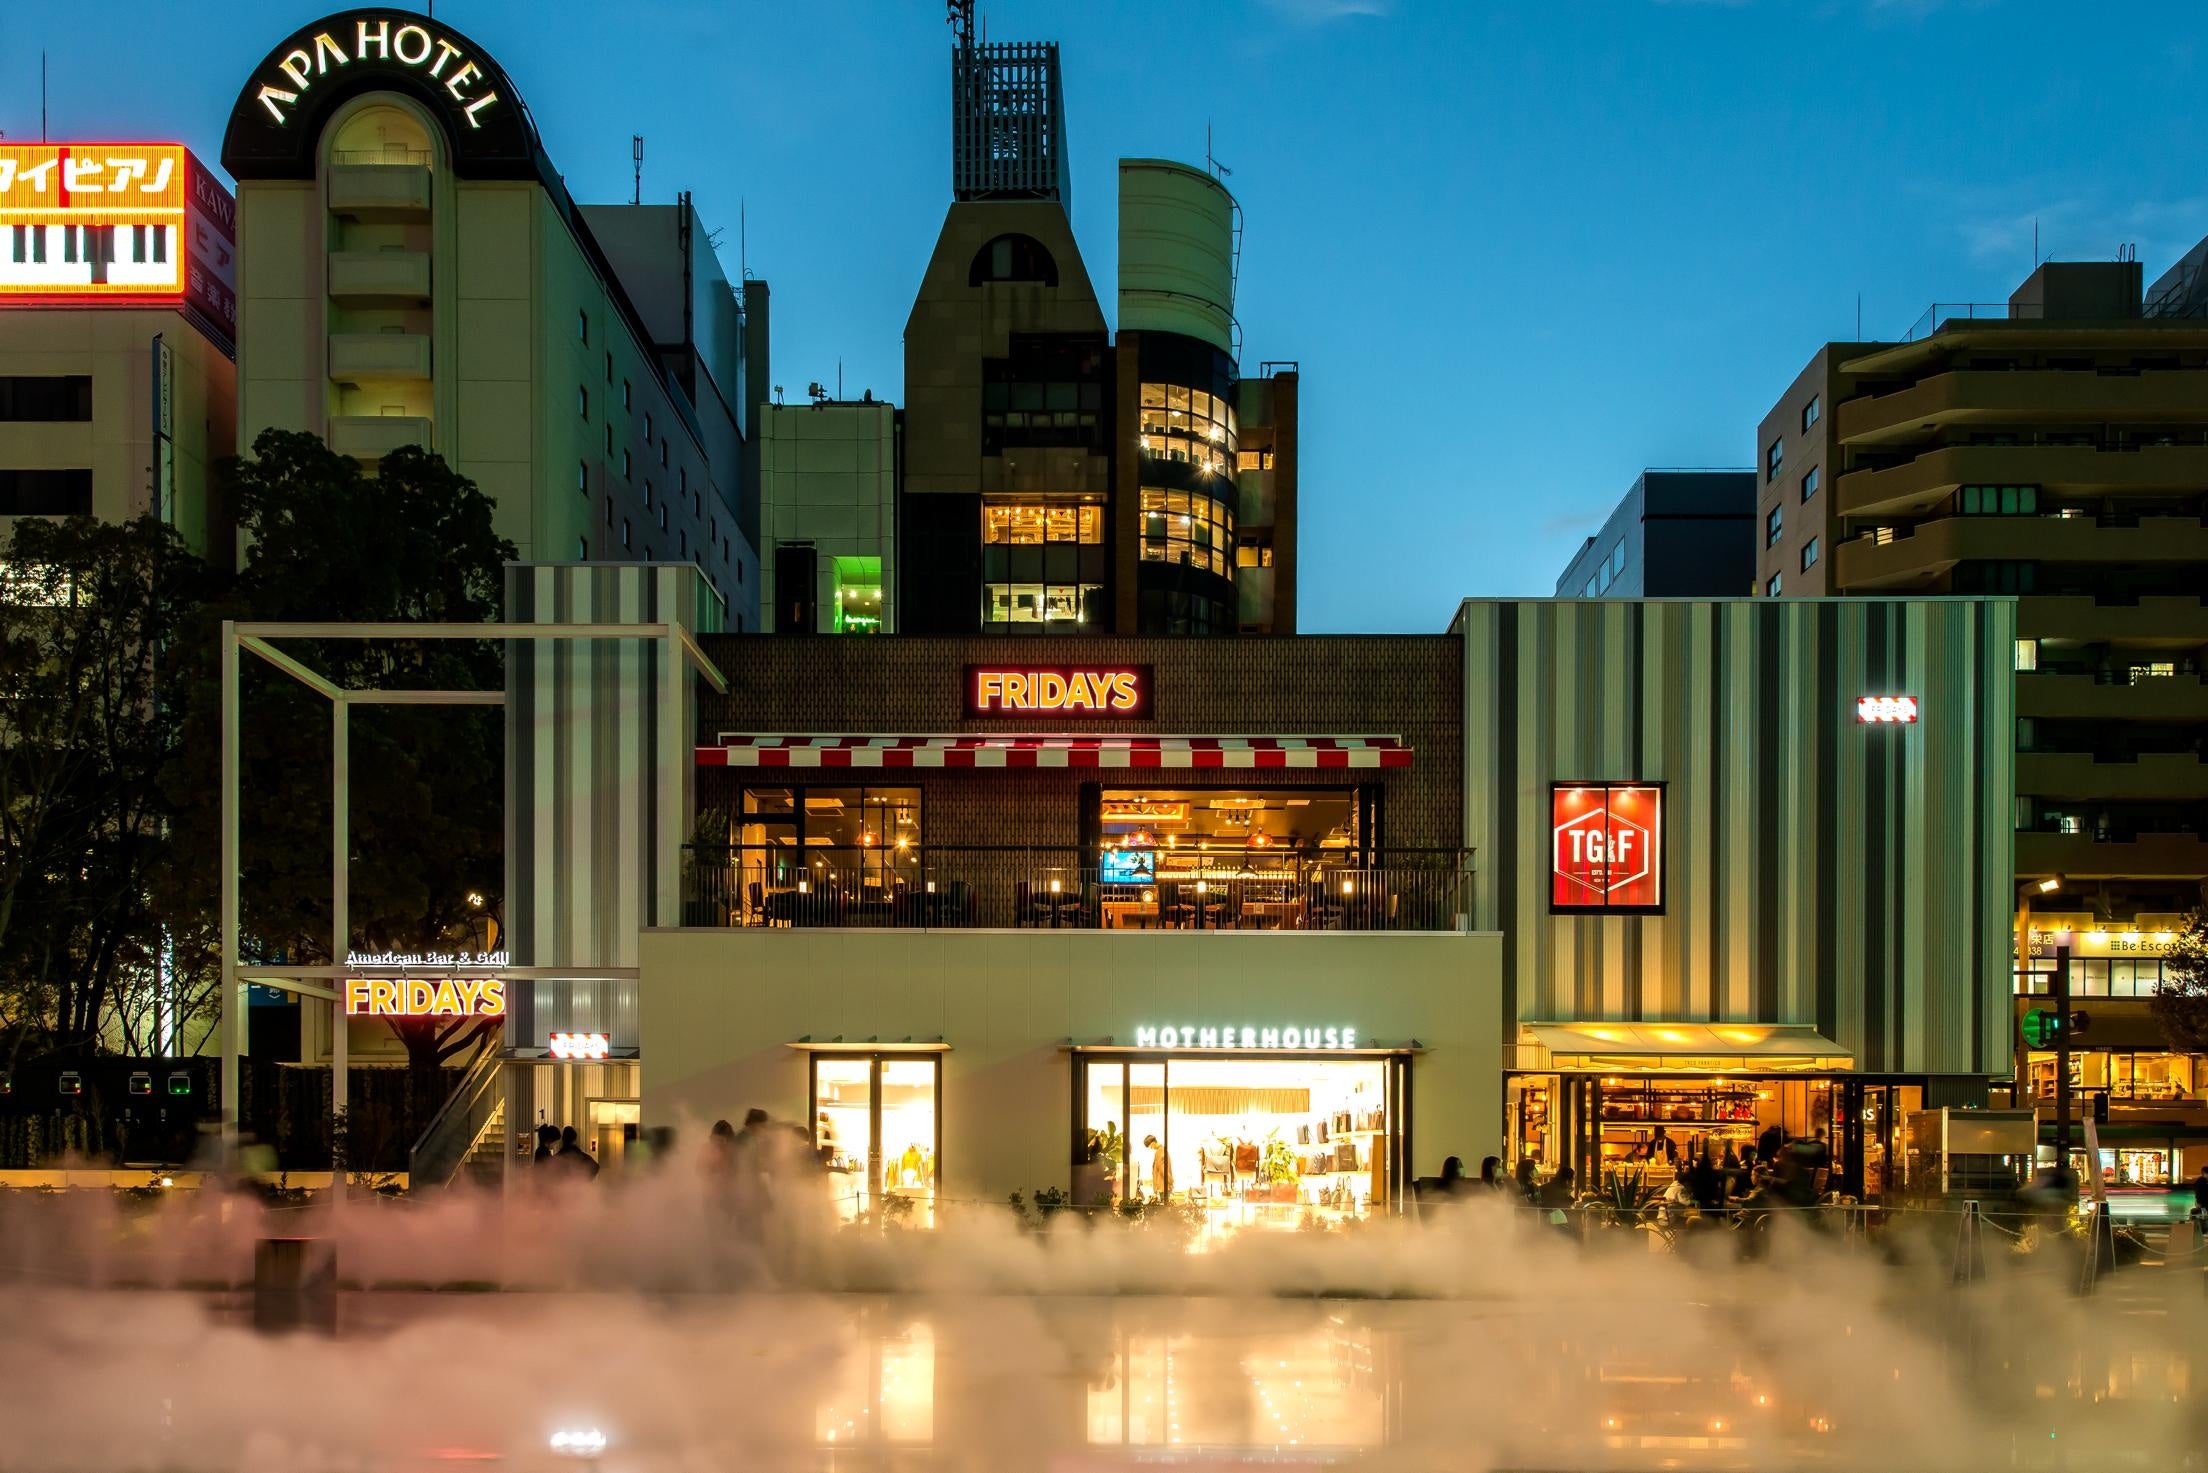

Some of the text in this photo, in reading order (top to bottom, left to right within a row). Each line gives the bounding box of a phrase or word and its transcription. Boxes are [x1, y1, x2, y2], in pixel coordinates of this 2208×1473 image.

[257, 21, 498, 128] APA HOTEL
[195, 171, 236, 231] KAW
[978, 672, 1137, 709] FRIDAYS
[346, 951, 509, 964] American Bar & Grill
[346, 979, 506, 1016] FRIDAYS
[1136, 1026, 1356, 1048] MOTHERHOUSE
